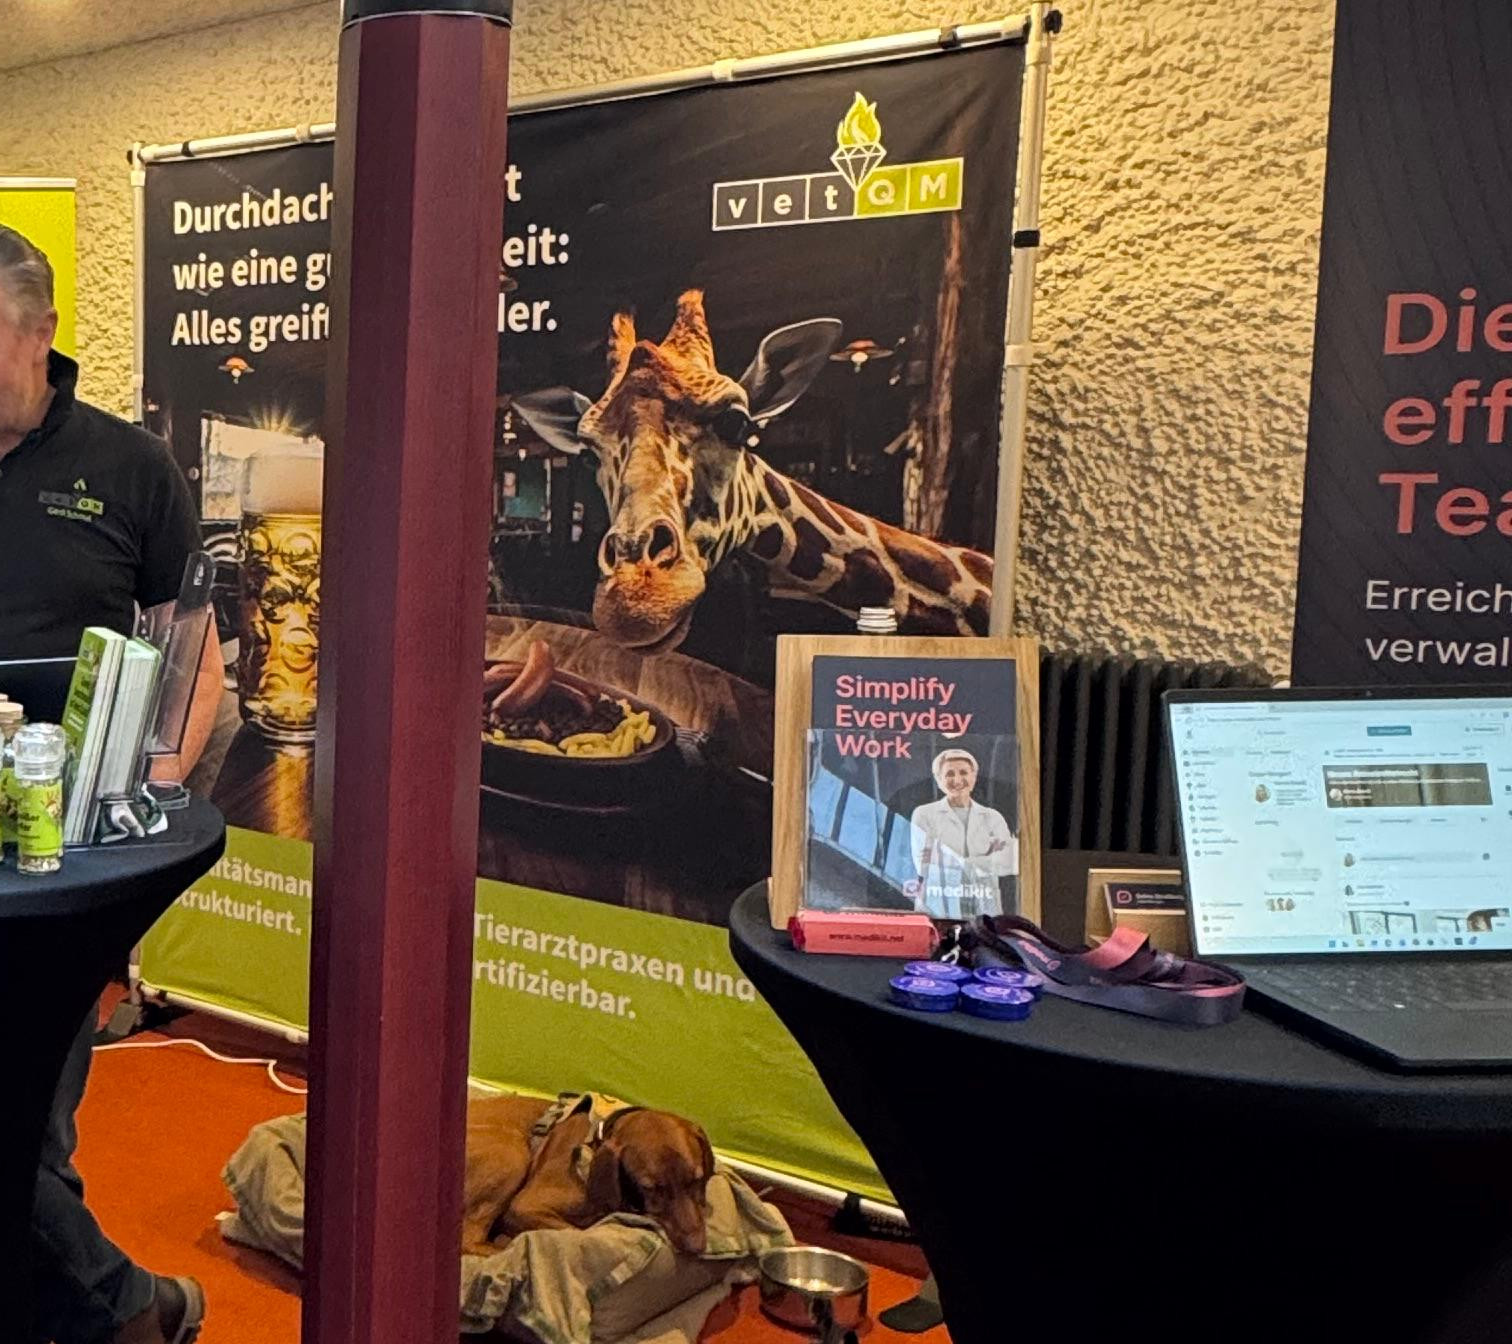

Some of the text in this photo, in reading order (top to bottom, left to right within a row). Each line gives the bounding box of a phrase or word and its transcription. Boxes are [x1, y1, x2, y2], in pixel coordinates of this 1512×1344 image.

[174, 182, 333, 234] Durchdach
[173, 253, 224, 290] wie
[231, 248, 297, 287] eine
[502, 223, 569, 267] eit:
[171, 309, 241, 346] Alles
[1383, 378, 1512, 446] eff
[1366, 580, 1512, 613] Erreich
[1365, 636, 1510, 667] verwal
[836, 674, 955, 705] Simplify
[836, 704, 973, 736] Everyday
[835, 733, 912, 759] Work
[209, 857, 312, 898] itätsman
[927, 884, 993, 899] medikit
[180, 890, 302, 935] trukturiert.
[474, 911, 684, 986] Tierarztpraxen
[474, 959, 636, 1019] rtifizierbar.
